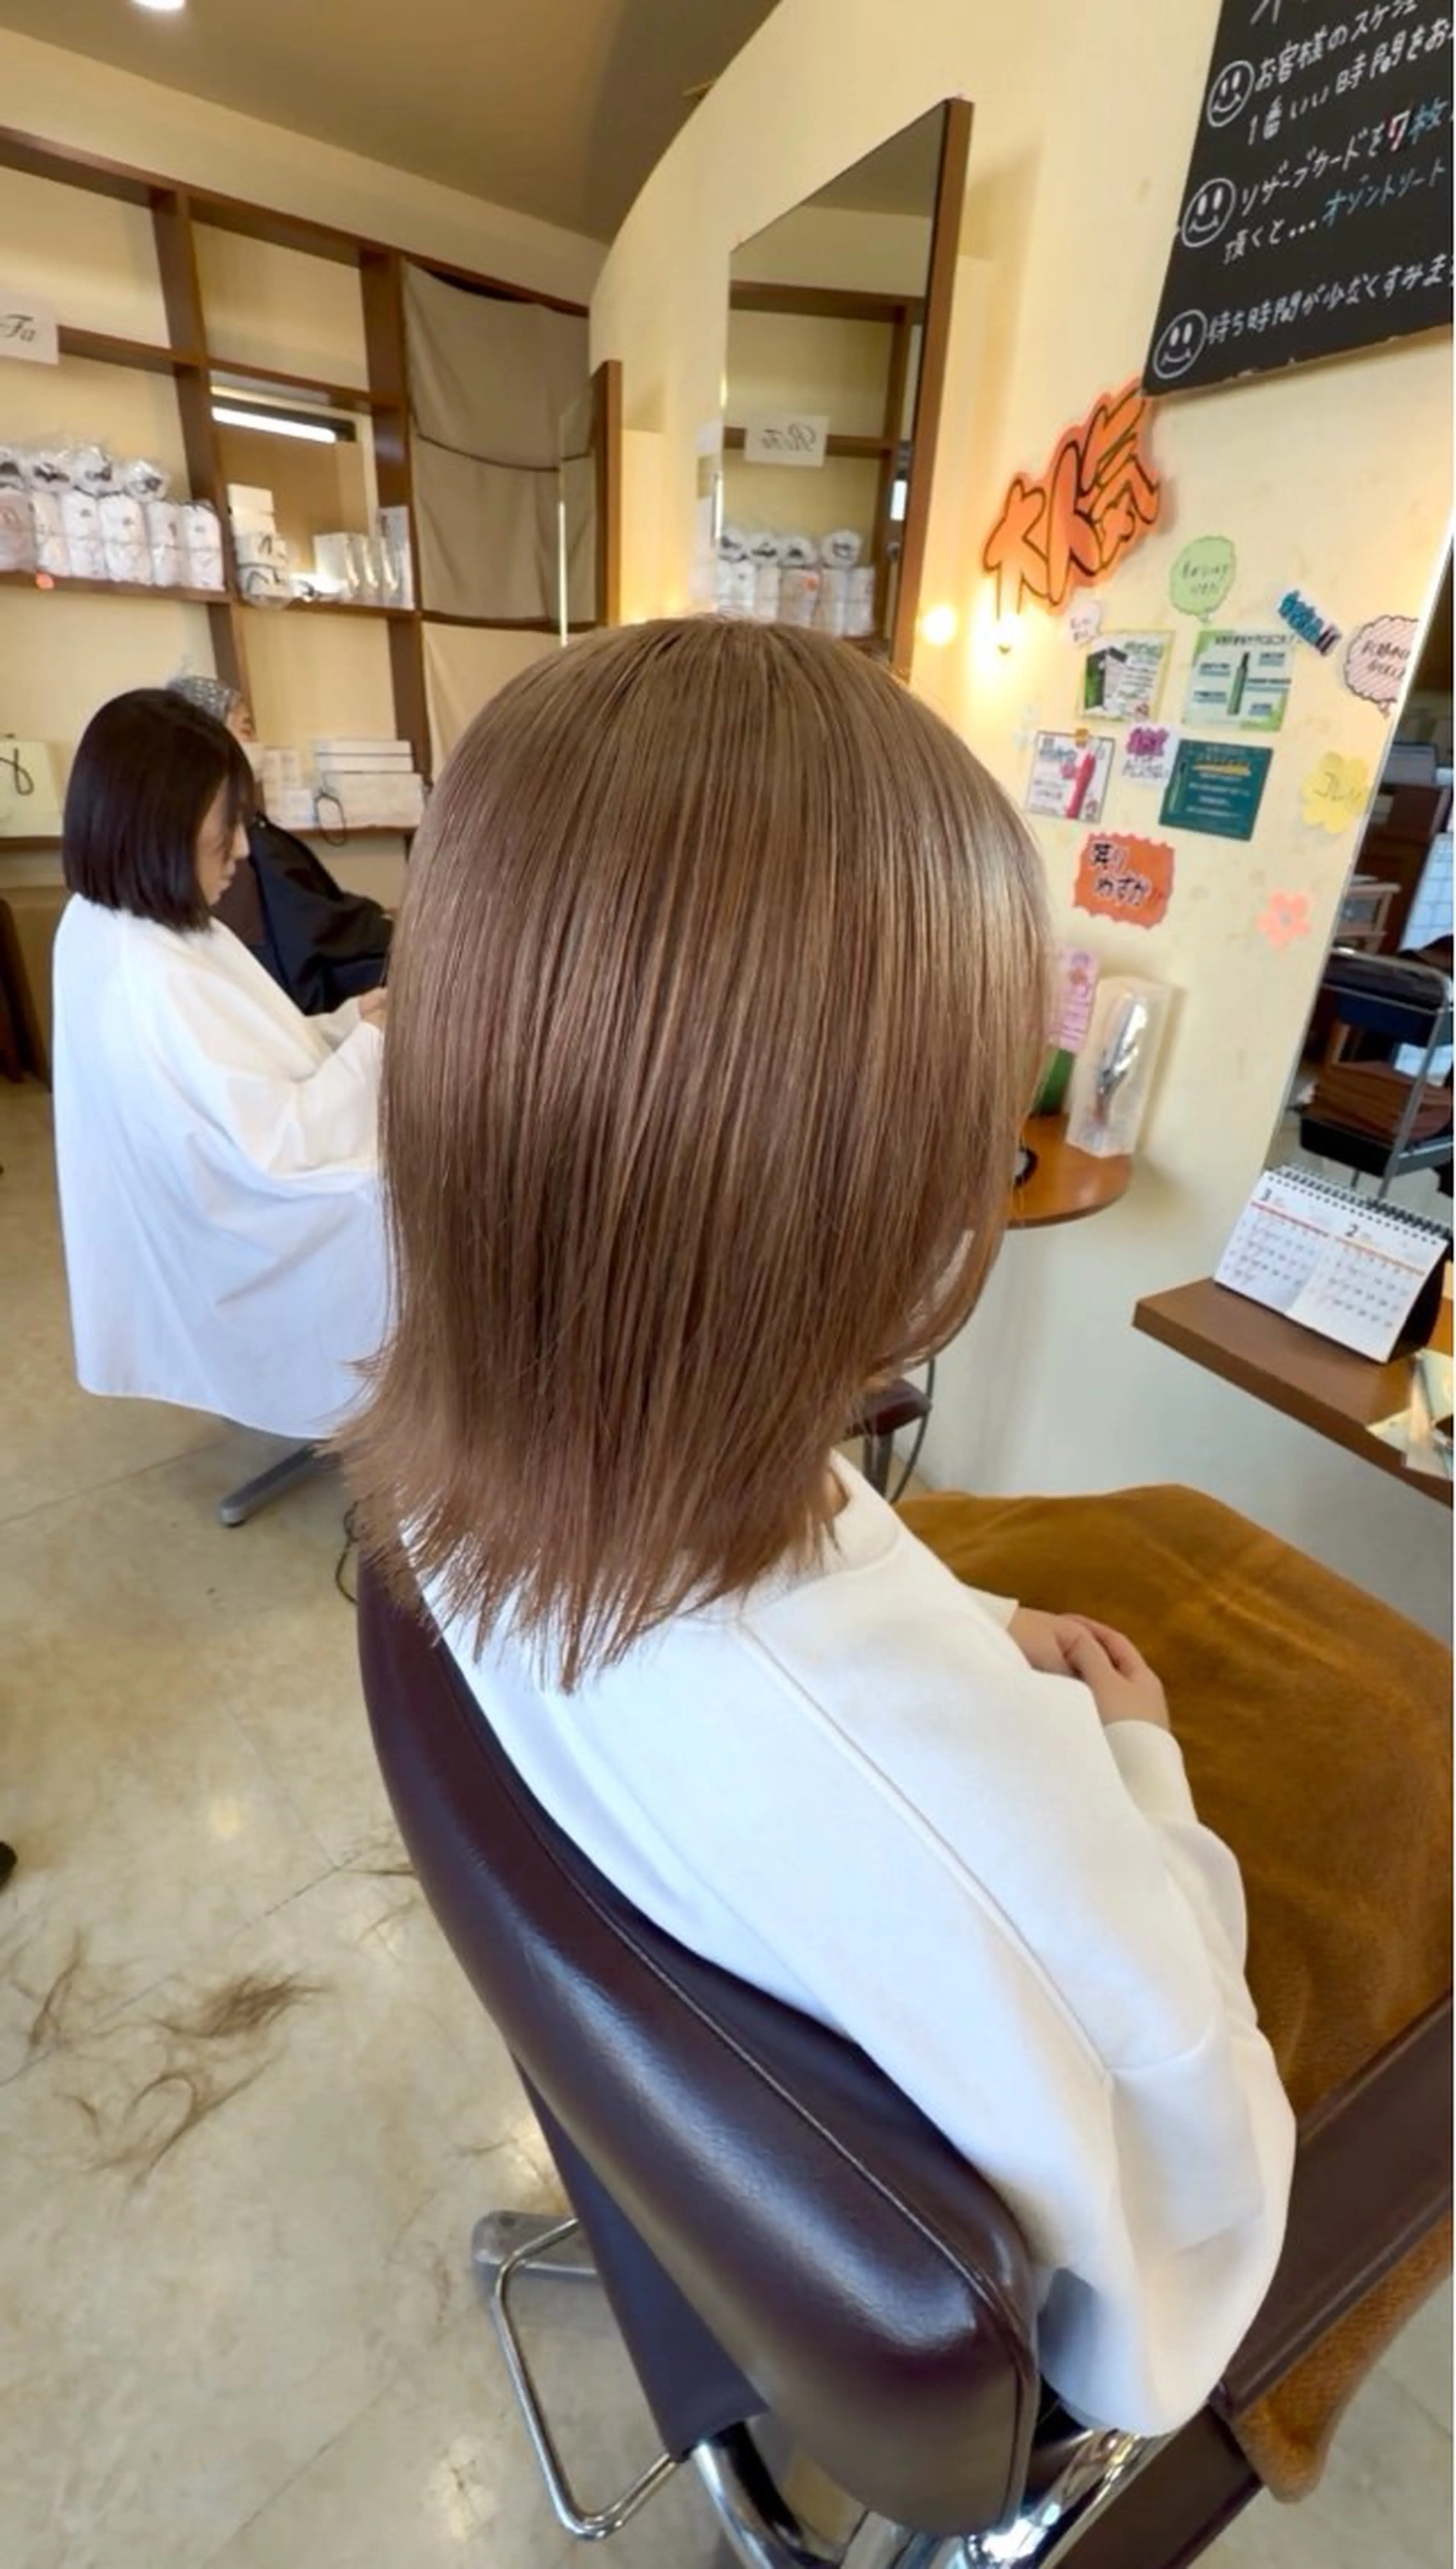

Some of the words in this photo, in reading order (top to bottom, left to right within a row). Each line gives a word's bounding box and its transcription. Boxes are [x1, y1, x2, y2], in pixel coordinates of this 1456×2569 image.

[1209, 253, 1454, 345] 待ち時間が少なくすみま
